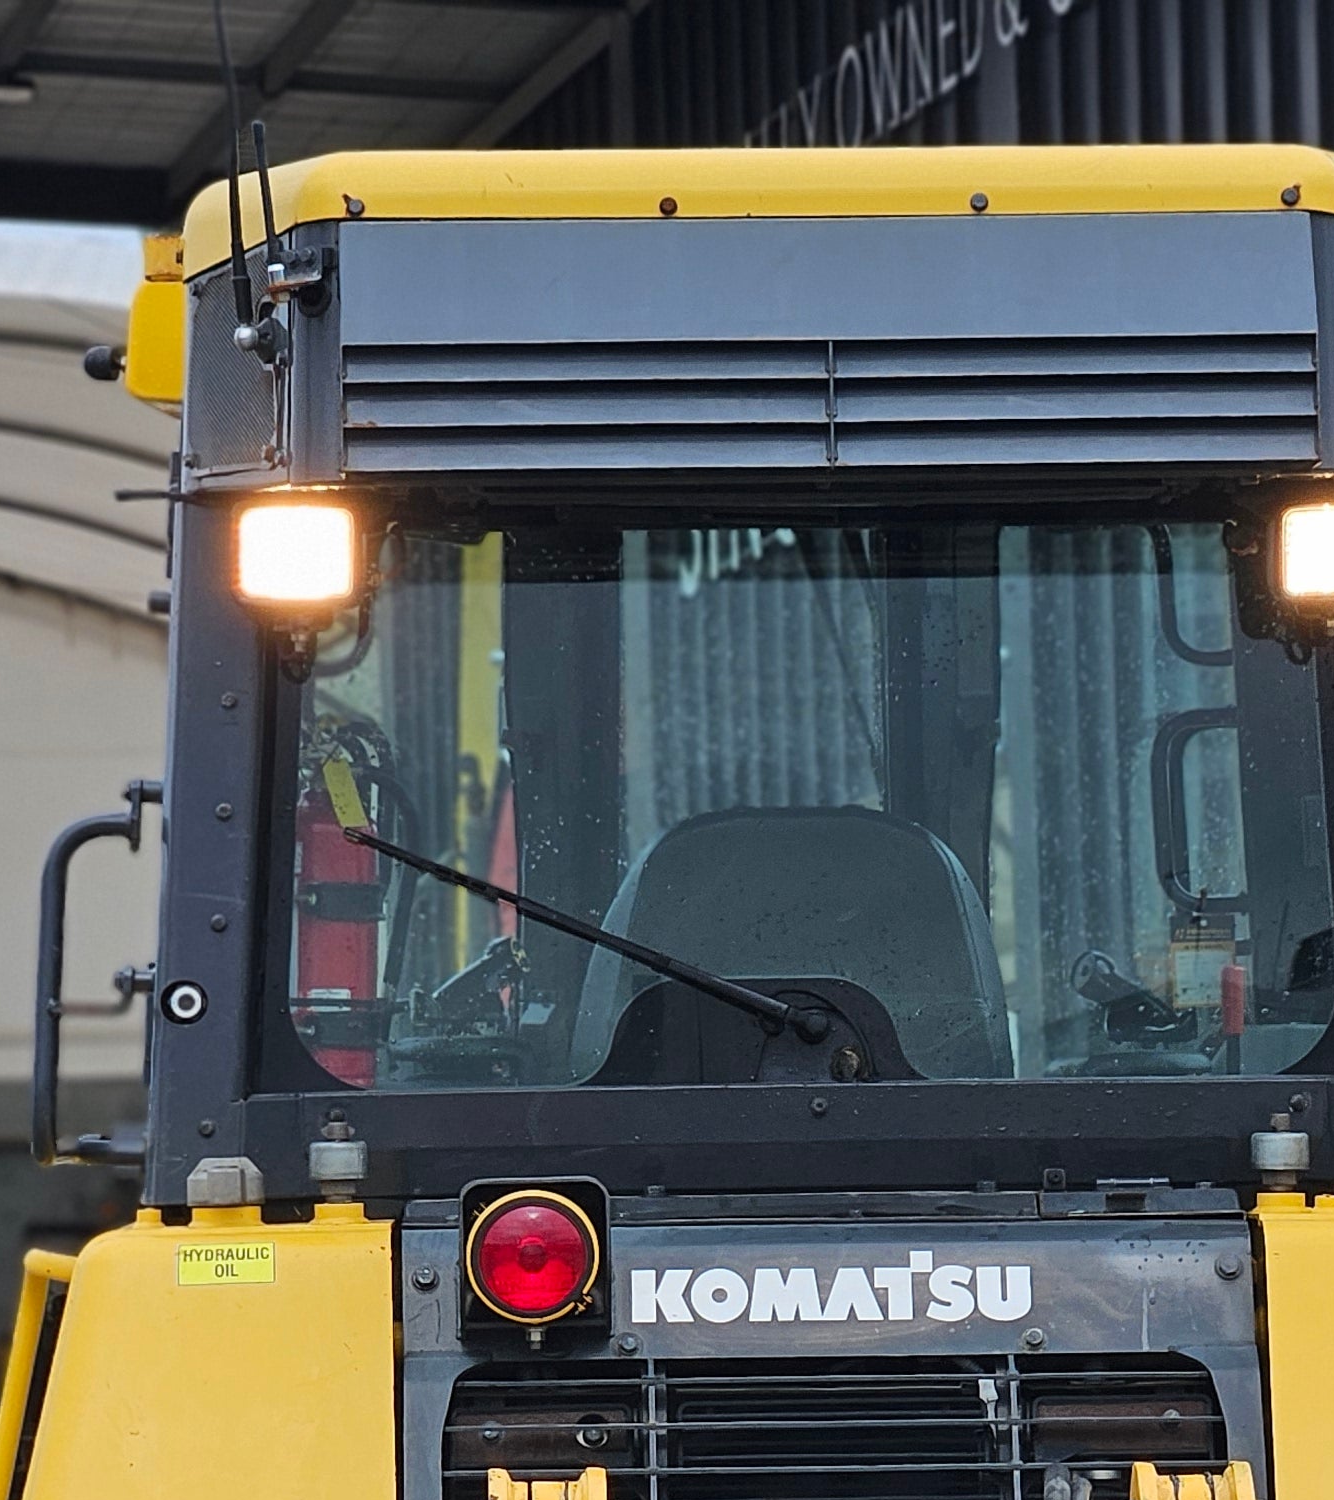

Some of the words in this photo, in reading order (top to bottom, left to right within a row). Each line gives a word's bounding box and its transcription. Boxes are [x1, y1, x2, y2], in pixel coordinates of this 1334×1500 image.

[834, 0, 985, 148] OWNED
[182, 1246, 270, 1263] HYDRAULIC
[214, 1263, 240, 1278] OIL
[630, 1250, 1033, 1324] KOMATSU
